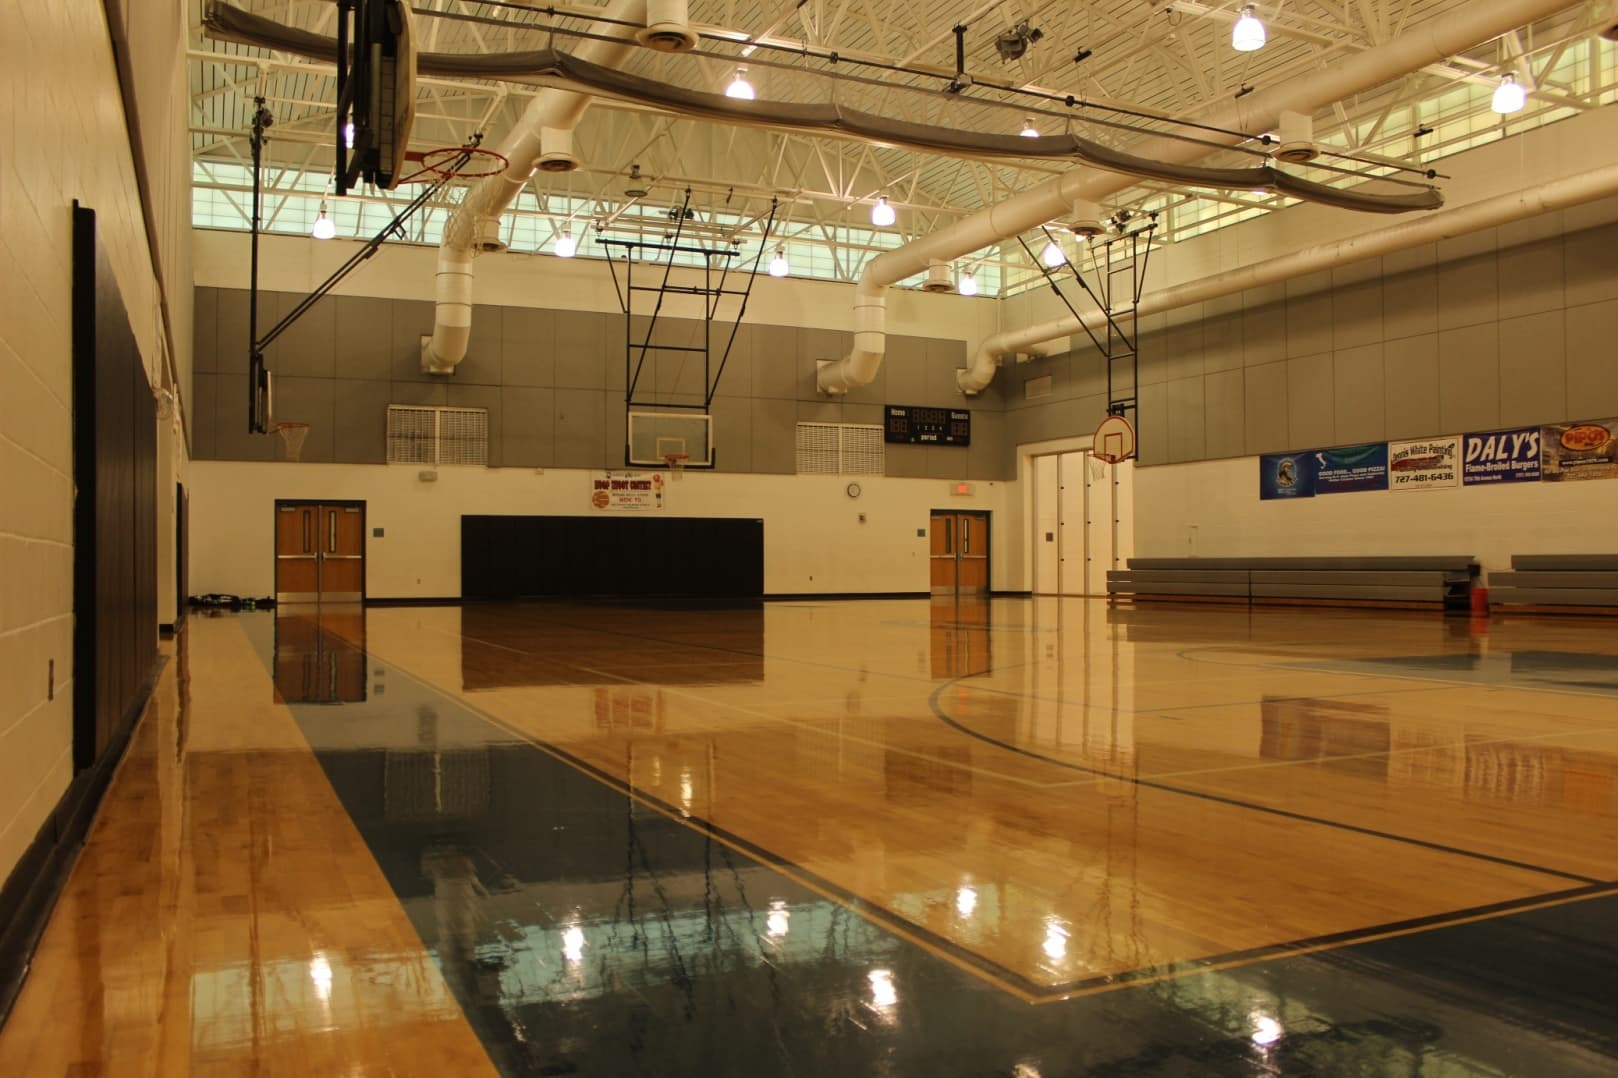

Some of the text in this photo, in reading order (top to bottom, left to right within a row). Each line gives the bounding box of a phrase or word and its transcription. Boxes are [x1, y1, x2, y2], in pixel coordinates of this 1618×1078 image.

[1410, 445, 1428, 456] White
[1428, 443, 1453, 459] Painting
[1466, 432, 1539, 462] DALY'S
[1465, 460, 1510, 473] Flame-Broiled
[1511, 460, 1539, 471] Burgers
[1395, 472, 1454, 483] 727-481-6436
